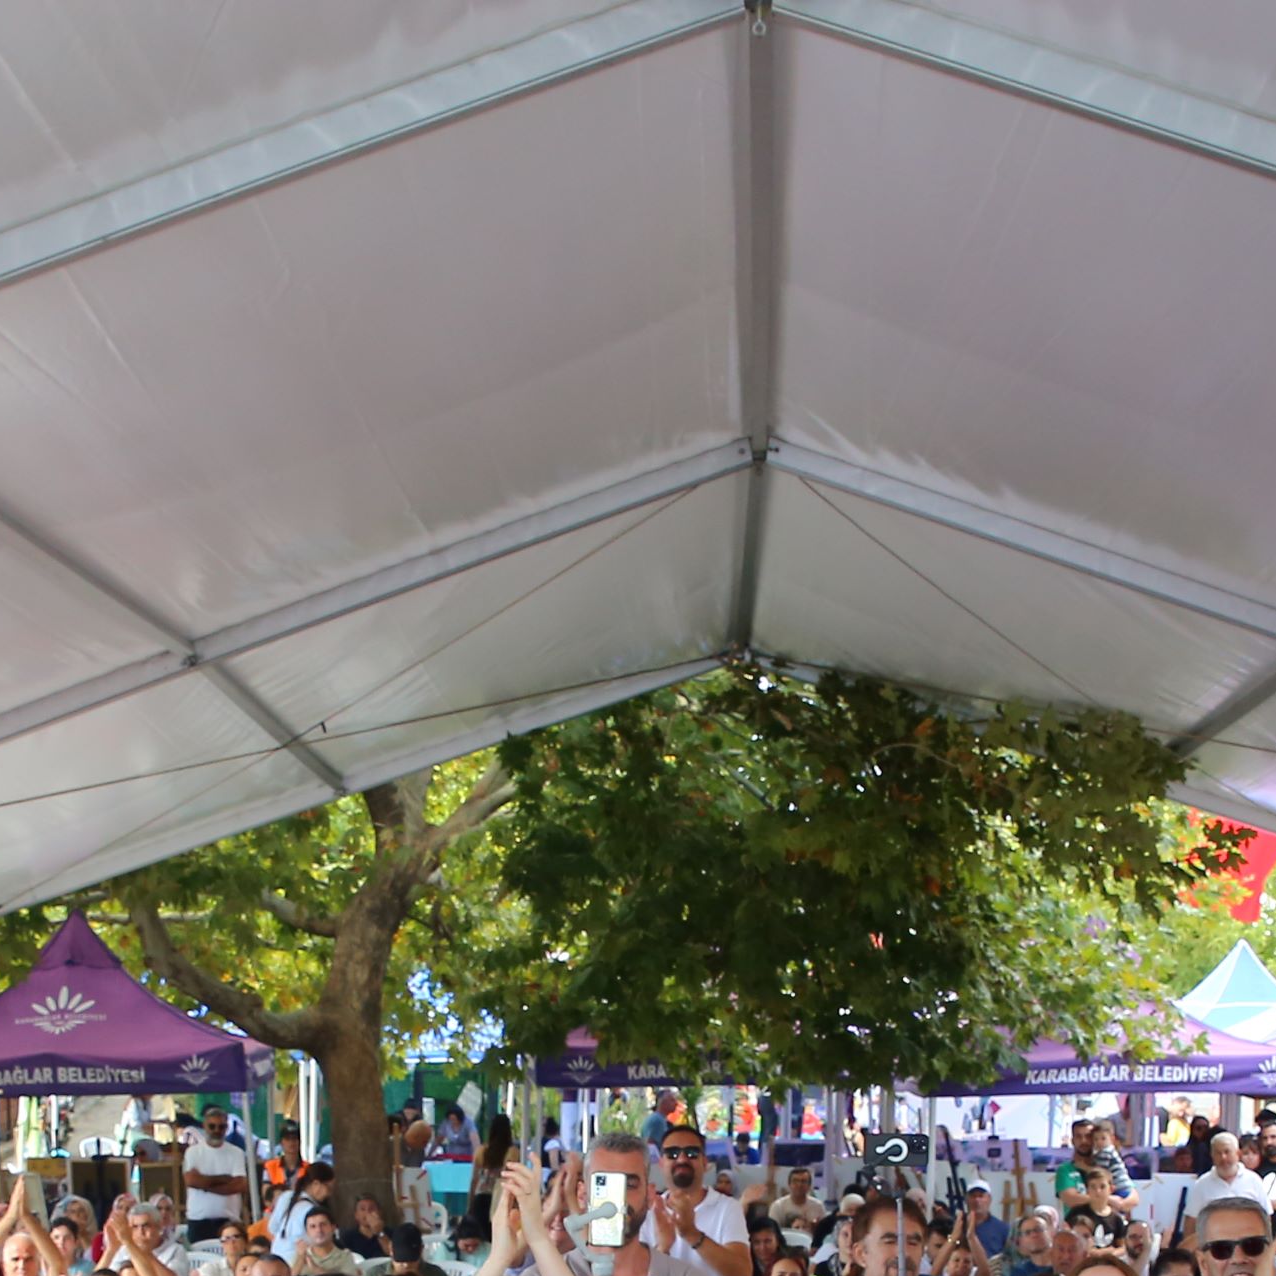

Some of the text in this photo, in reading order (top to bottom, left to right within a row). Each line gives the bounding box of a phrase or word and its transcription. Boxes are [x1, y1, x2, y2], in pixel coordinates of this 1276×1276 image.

[57, 1064, 145, 1084] BELEDİYESİ
[1025, 1062, 1223, 1085] KARABAĞLAR BELEDİYESİ
